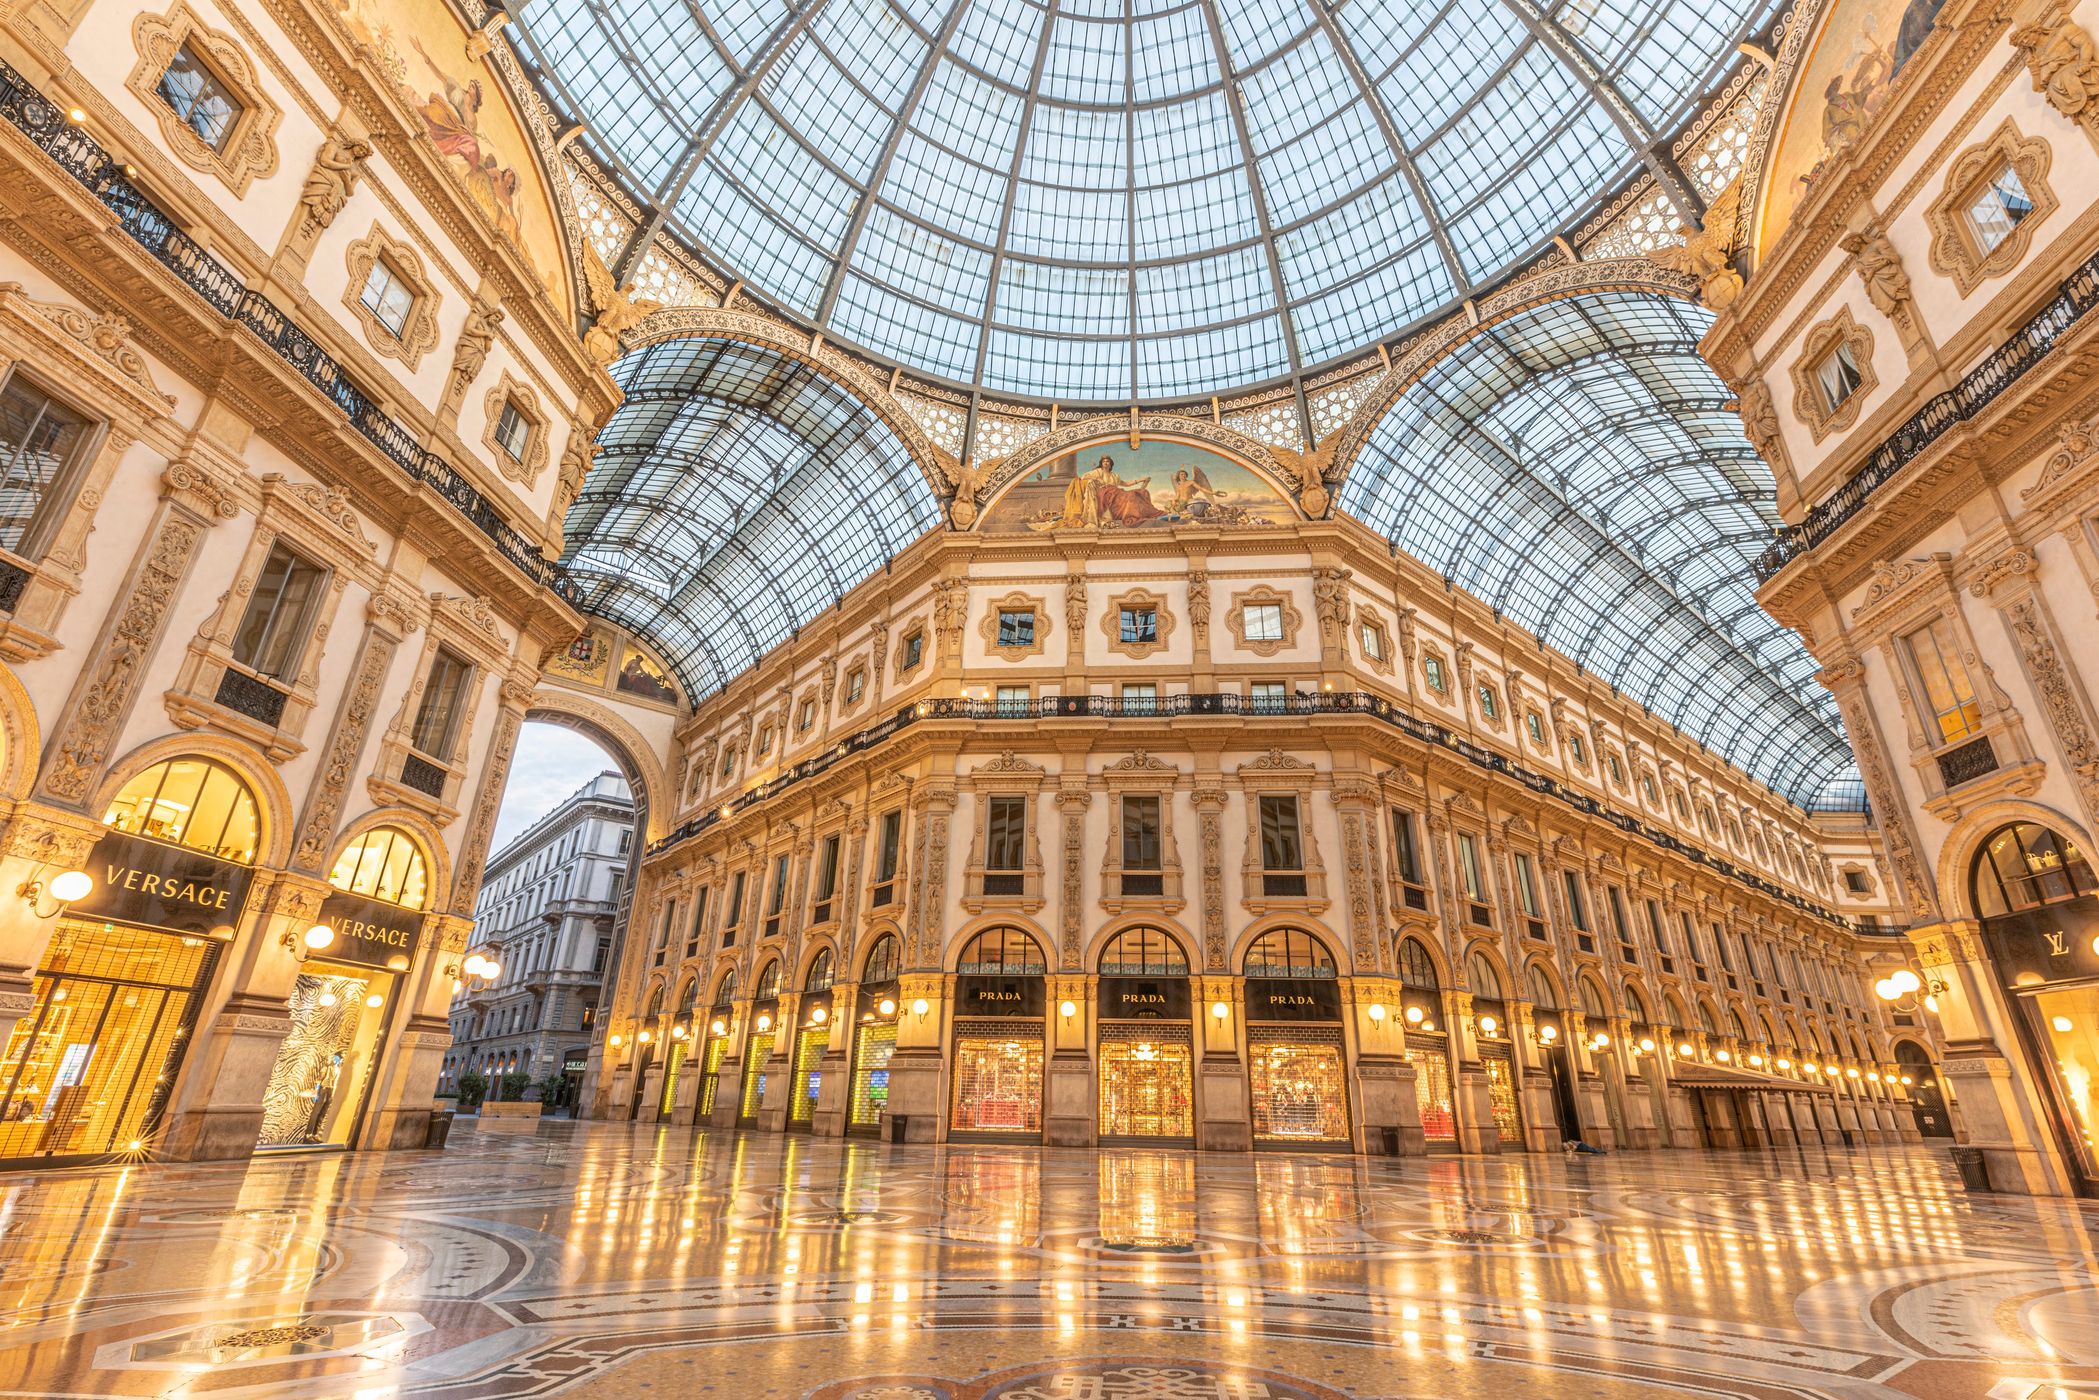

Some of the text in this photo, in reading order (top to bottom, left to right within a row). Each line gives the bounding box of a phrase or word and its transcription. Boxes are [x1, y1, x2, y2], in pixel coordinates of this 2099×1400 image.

[107, 864, 231, 910] VERSACE
[331, 915, 410, 948] VERSACE
[979, 991, 1022, 1001] PRADA
[1122, 994, 1166, 1003] PRADA
[1270, 995, 1315, 1005] PRADA
